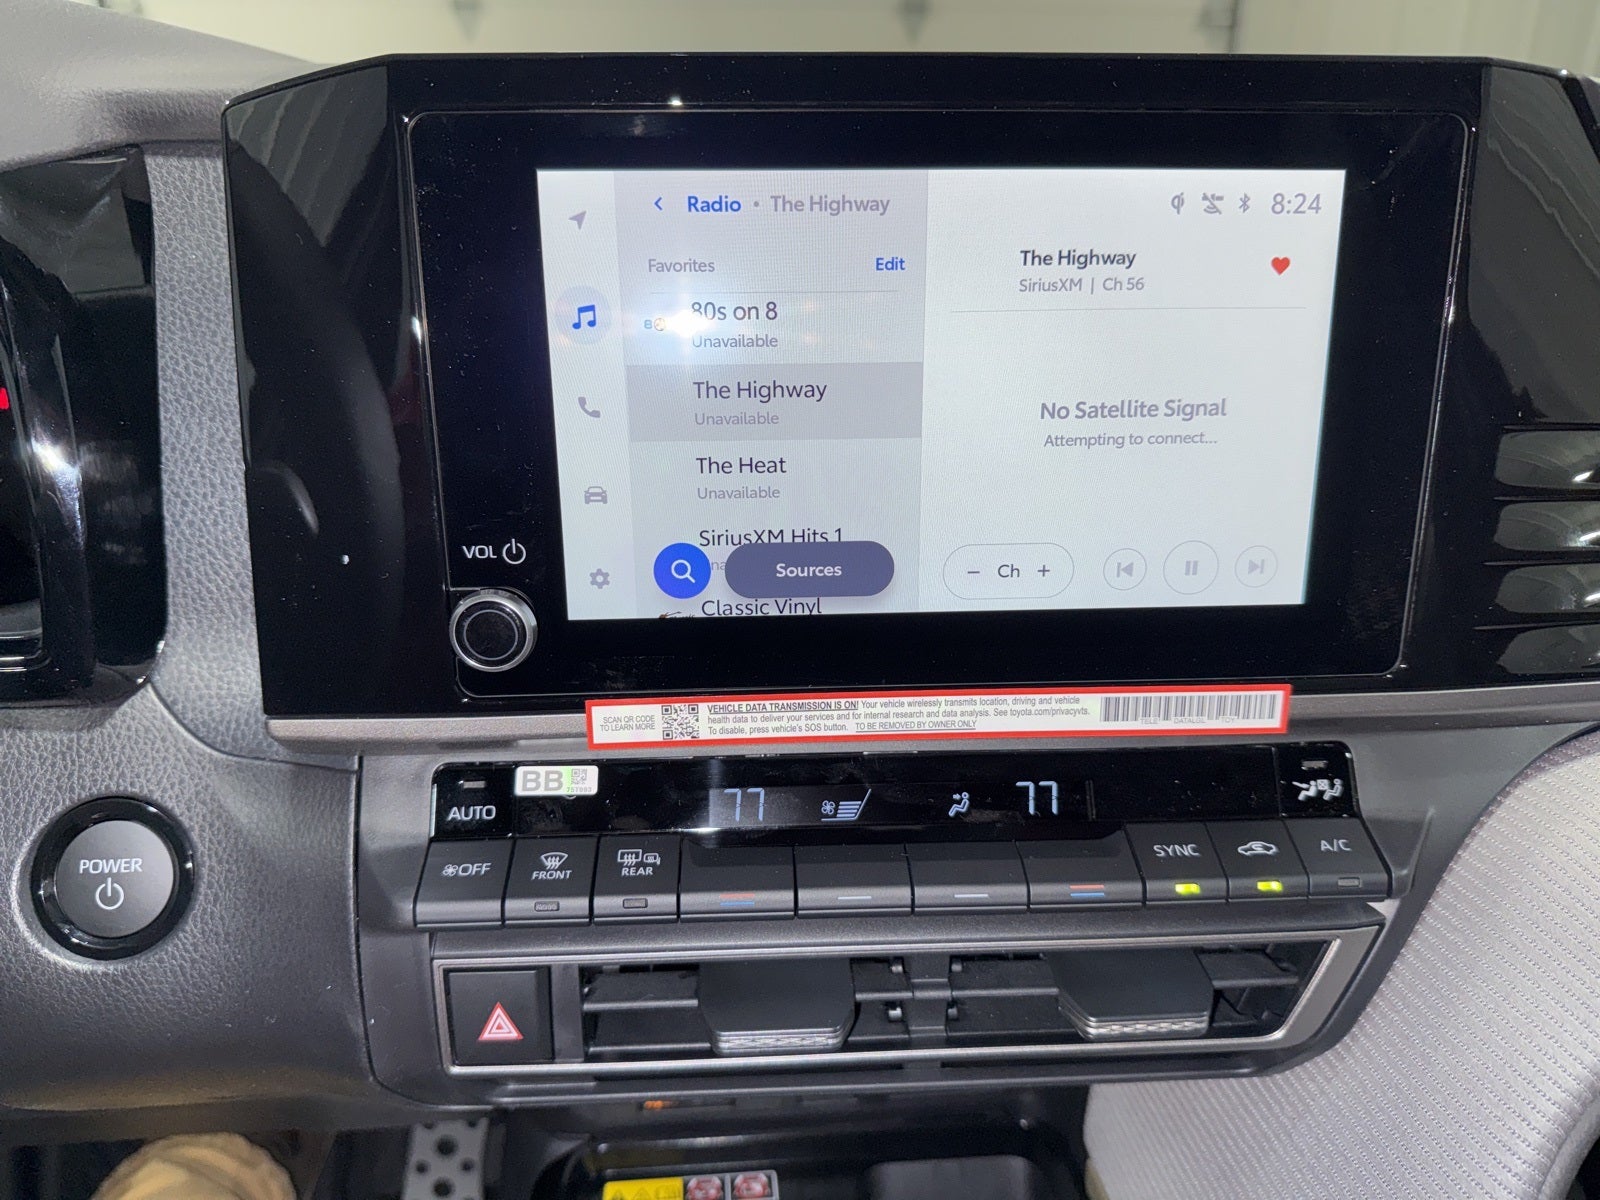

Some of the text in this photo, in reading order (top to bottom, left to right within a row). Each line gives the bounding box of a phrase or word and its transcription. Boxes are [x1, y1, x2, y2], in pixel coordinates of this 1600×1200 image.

[687, 194, 890, 216] Radio The Highway
[1271, 193, 1322, 215] 8:24
[648, 258, 715, 273] Favorites
[875, 257, 905, 272] Edit
[1020, 249, 1136, 270] The Highway
[1019, 277, 1145, 292] SiriusXM Ch 56
[692, 301, 778, 320] 80s on 8
[692, 334, 778, 348] Unavailable
[693, 380, 827, 403] The Highway
[1040, 398, 1227, 421] No Satellite Signal
[694, 412, 780, 426] Unavailable
[1044, 432, 1218, 449] Attempting to connect...
[696, 457, 787, 474] The Heat
[697, 487, 781, 500] Unavailable
[699, 528, 842, 547] SiriusXM Hits 1
[462, 545, 498, 559] VOL
[776, 563, 842, 577] Sources
[998, 564, 1020, 579] Ch
[701, 598, 822, 616] Classic Vinyl
[707, 704, 743, 713] VEHICLE
[746, 703, 767, 712] DATA
[769, 701, 832, 711] TRANSMISSION
[834, 701, 842, 710] IS
[844, 700, 859, 709] ON!
[861, 700, 878, 709] Your
[880, 700, 905, 708] vehicle
[907, 699, 942, 709] wirelessly
[944, 698, 977, 707] transmits
[1011, 696, 1036, 707] driving
[1038, 696, 1052, 704] and
[1054, 696, 1080, 704] vehicle
[603, 716, 622, 724] SCAN
[636, 715, 655, 723] CODE
[708, 716, 731, 724] health
[732, 715, 748, 723] data
[750, 715, 758, 723] to
[760, 714, 784, 722] deliver
[786, 715, 803, 724] your
[804, 713, 835, 721] services
[836, 712, 850, 720] and
[852, 711, 861, 720] for
[864, 711, 890, 719] internal
[893, 710, 924, 718] research
[926, 710, 940, 718] and
[942, 709, 958, 717] data
[960, 708, 991, 718] analysis.
[993, 708, 1008, 716] See
[611, 723, 634, 731] LEARN
[635, 723, 655, 731] MORE
[708, 719, 977, 735] To disable, press vehicle's SOS button. TO BE REMOVED BY OWNER ONLY
[522, 770, 563, 791] BB
[724, 788, 765, 821] 77
[1015, 781, 1058, 816] 77
[447, 805, 496, 821] AUTO
[1153, 844, 1201, 857] SYNC
[1320, 839, 1352, 852] A/C
[79, 857, 143, 874] POWER
[458, 863, 491, 876] OFF
[621, 867, 653, 876] REAR
[531, 870, 572, 880] FRONT
